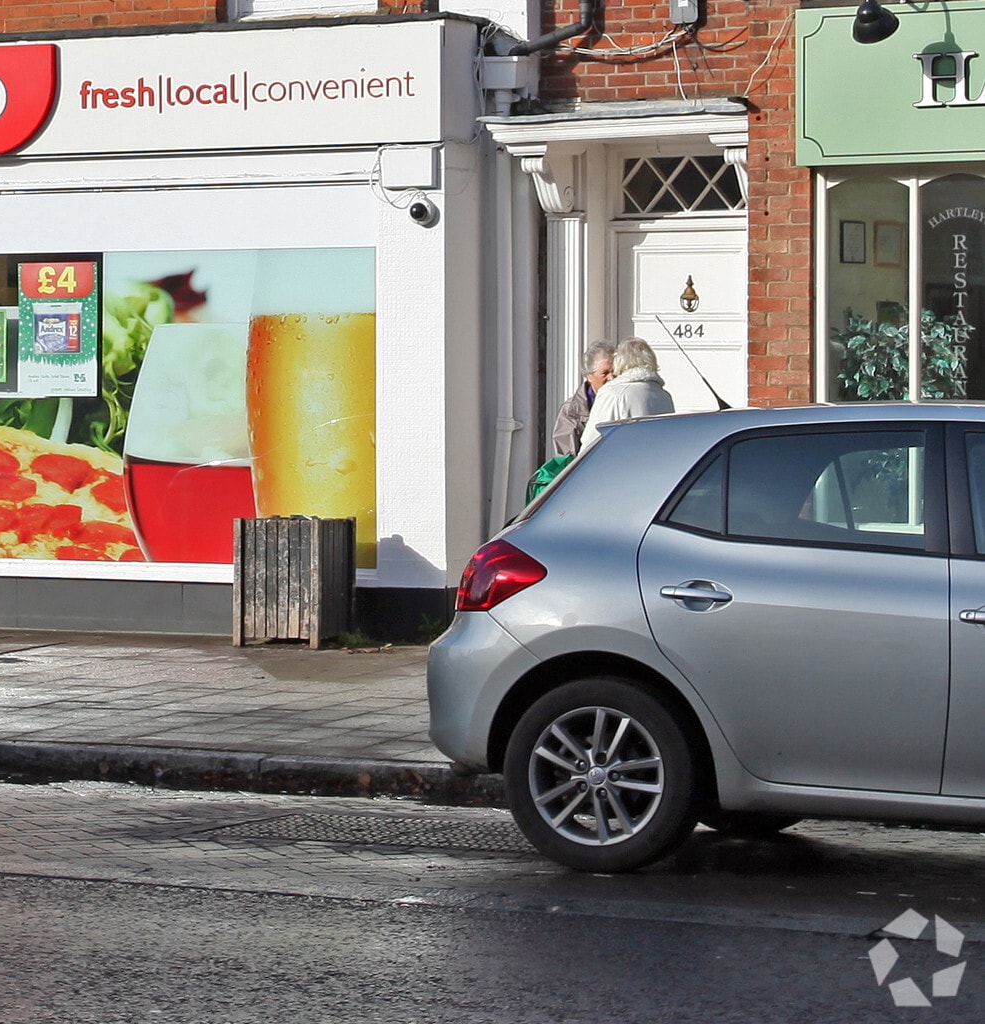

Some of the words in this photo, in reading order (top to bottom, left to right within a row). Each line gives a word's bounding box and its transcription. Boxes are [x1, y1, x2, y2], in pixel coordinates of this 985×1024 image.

[79, 77, 155, 109] fresh
[165, 74, 240, 106] local
[251, 71, 416, 103] convenient
[911, 51, 985, 107] H
[38, 266, 77, 294] £4
[68, 325, 78, 336] 12
[673, 324, 704, 338] 484
